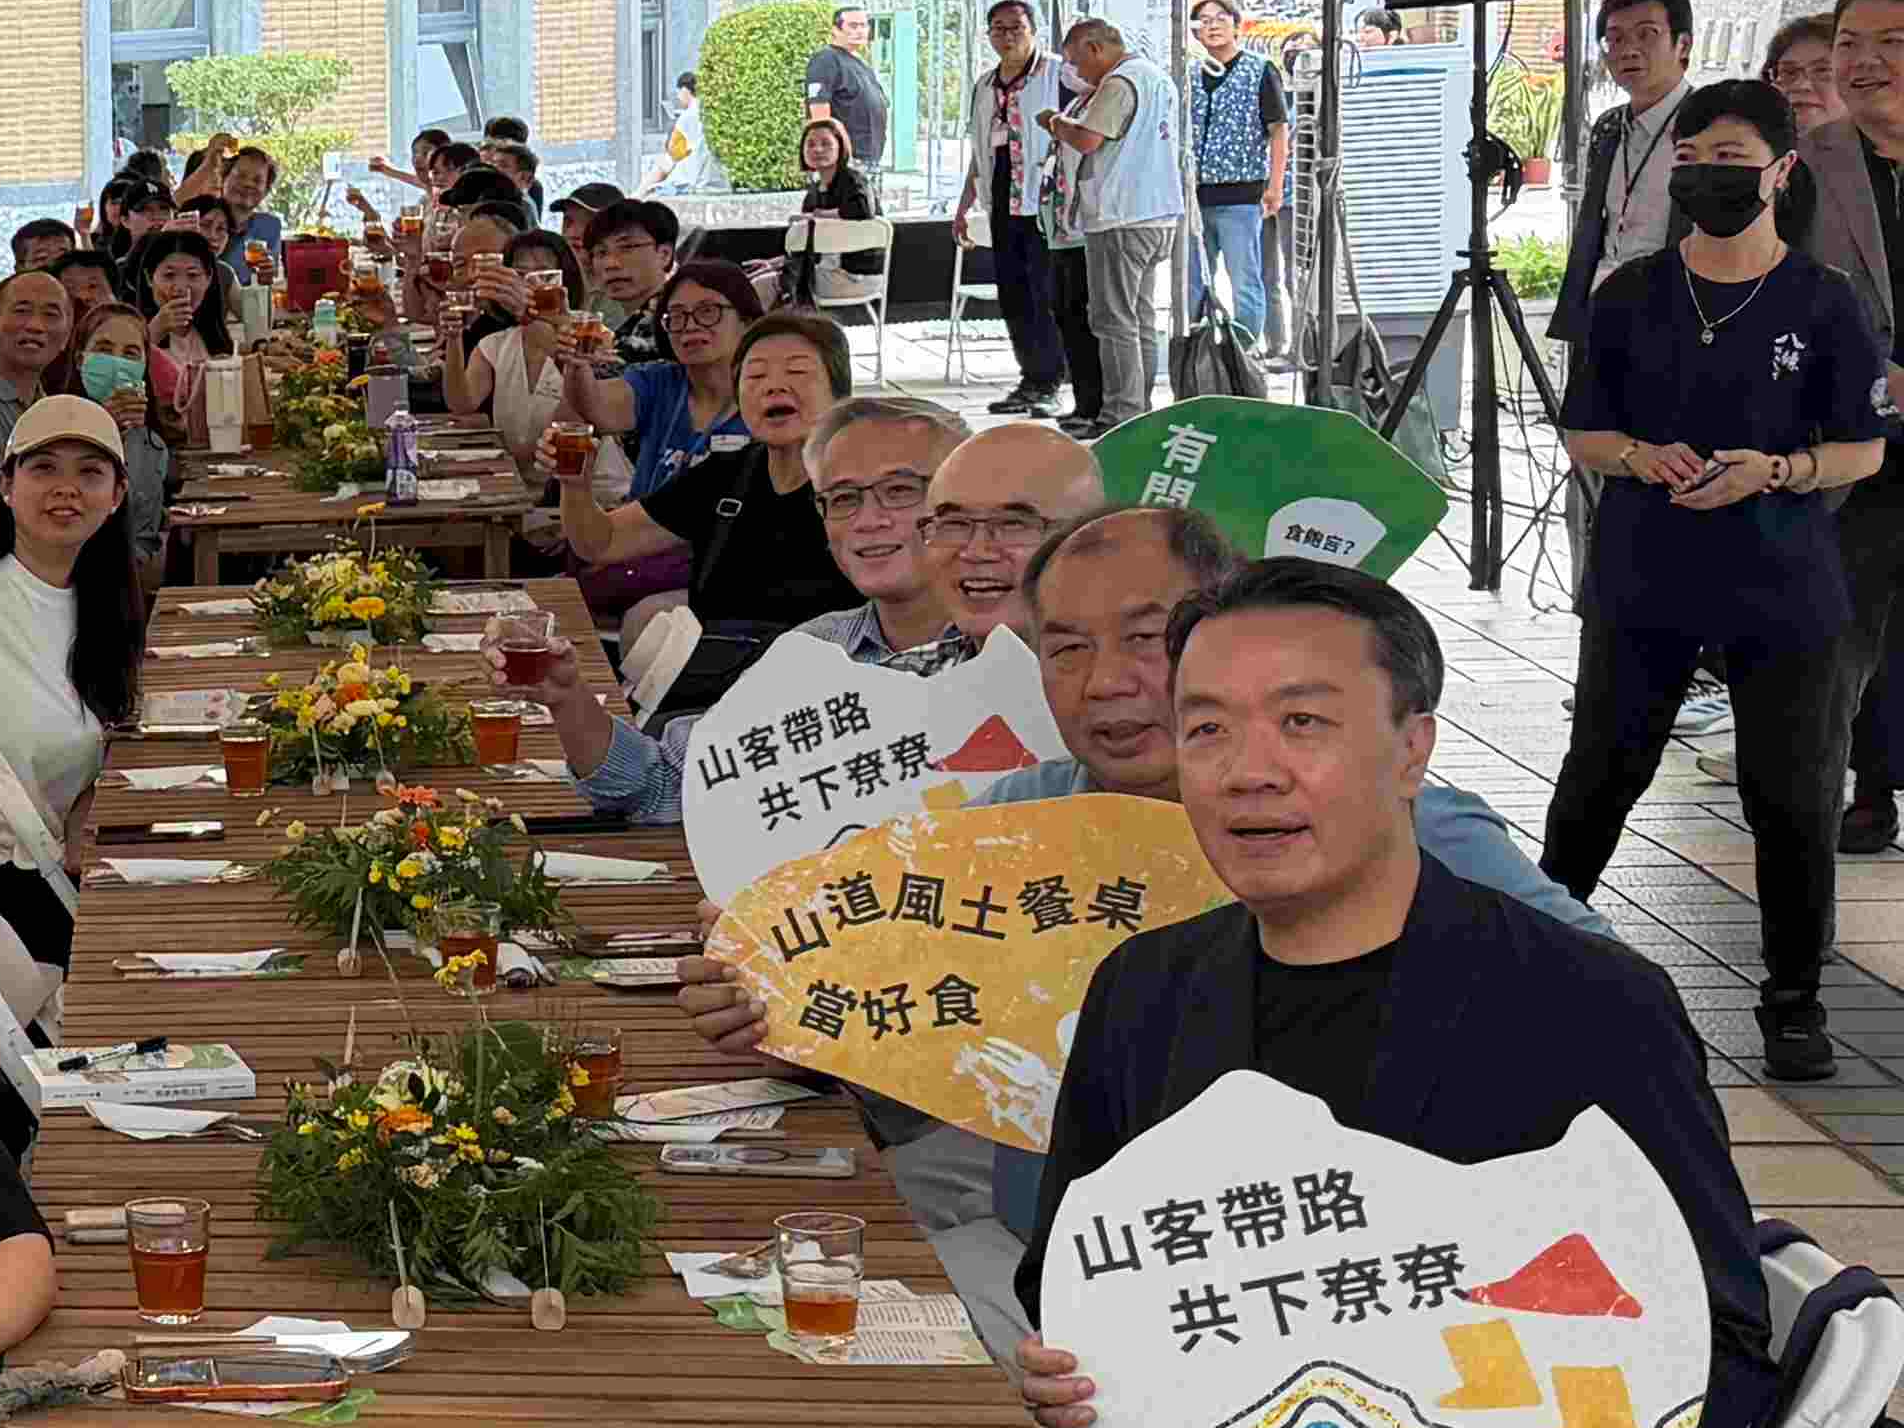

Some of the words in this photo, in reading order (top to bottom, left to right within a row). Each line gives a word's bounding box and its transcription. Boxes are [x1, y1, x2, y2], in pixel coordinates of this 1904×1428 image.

[697, 691, 873, 791] 山客帶路
[770, 870, 1148, 962] 山道風土餐桌
[799, 973, 983, 1041] 當好食
[1073, 1168, 1368, 1280] 山客帶路
